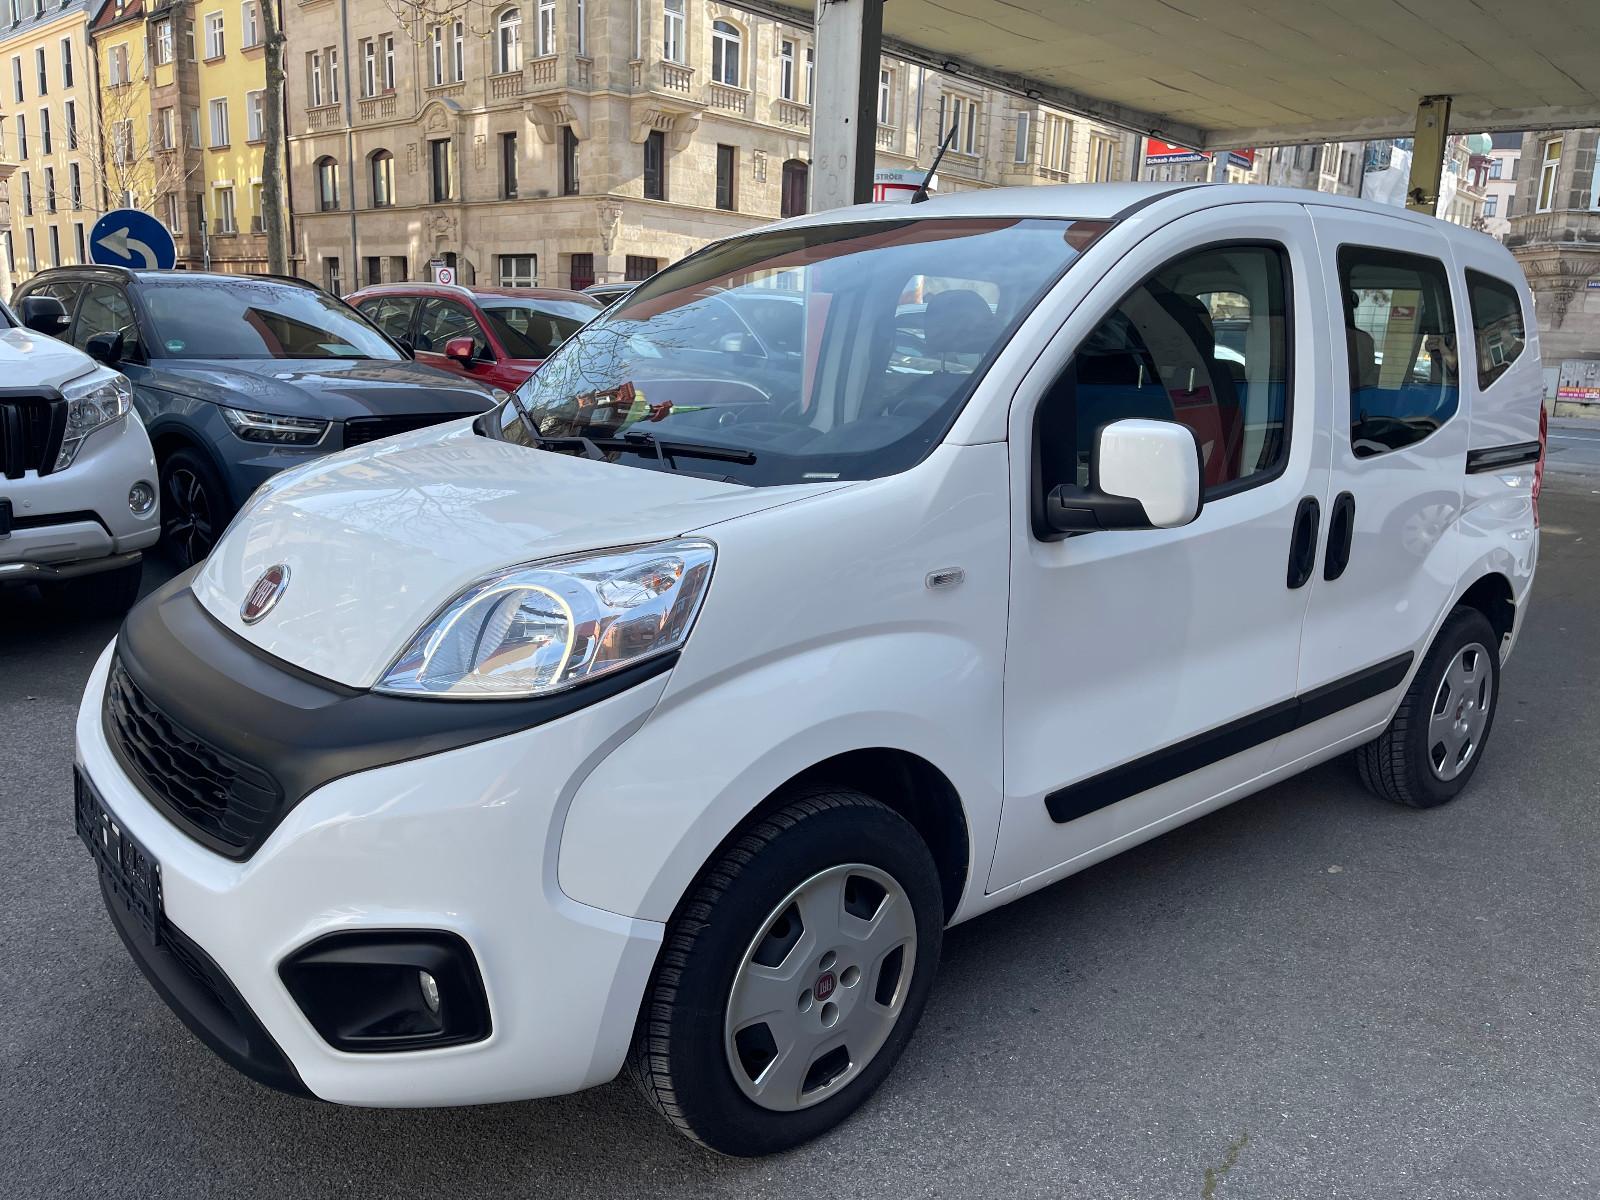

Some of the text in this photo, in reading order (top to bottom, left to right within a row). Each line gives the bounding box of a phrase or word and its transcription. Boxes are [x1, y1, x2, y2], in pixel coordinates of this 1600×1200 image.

[1146, 155, 1202, 165] Schaab Automobile
[875, 173, 903, 181] STRÖER
[249, 579, 278, 608] FIAT
